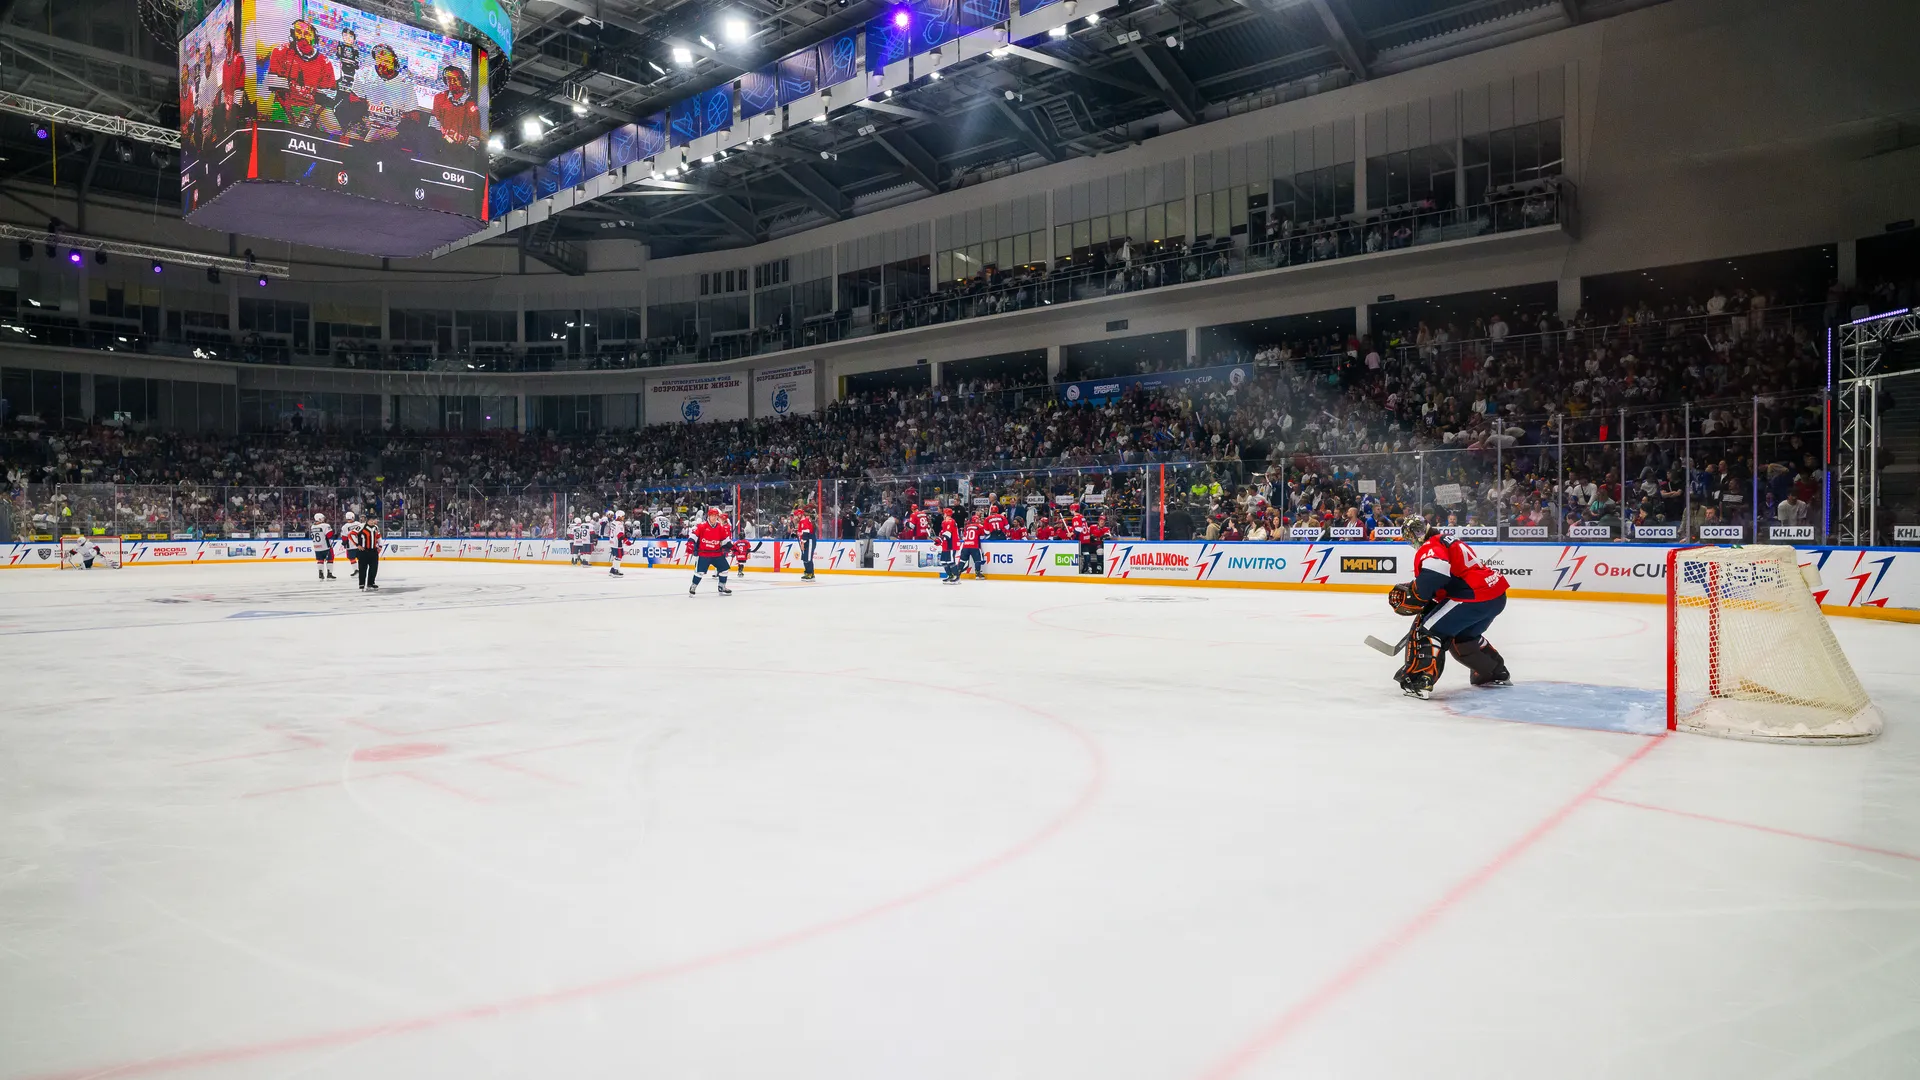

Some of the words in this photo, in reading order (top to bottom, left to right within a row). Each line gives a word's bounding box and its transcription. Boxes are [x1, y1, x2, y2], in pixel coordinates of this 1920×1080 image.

[288, 138, 316, 154] ДАЦ
[376, 161, 383, 173] 1
[442, 171, 465, 184] ОВИ
[653, 383, 709, 393] ВОЗРОЖДЕНИЕ
[710, 380, 740, 389] ЖИЗНИ
[1292, 528, 1320, 536] согаз
[1332, 528, 1361, 536] согаз
[1377, 528, 1401, 536] сога
[1462, 528, 1494, 536] согаз
[1511, 528, 1545, 536] согаз
[1573, 528, 1608, 537] согаз
[1638, 528, 1674, 537] согаз
[1703, 527, 1740, 537] согаз
[1772, 528, 1811, 538] KHL.RU
[647, 547, 668, 558] 895
[993, 554, 1014, 564] ПСБ
[1129, 552, 1154, 566] ПАПА
[1155, 552, 1189, 567] ДЖОНС
[1228, 556, 1287, 570] INVITRO
